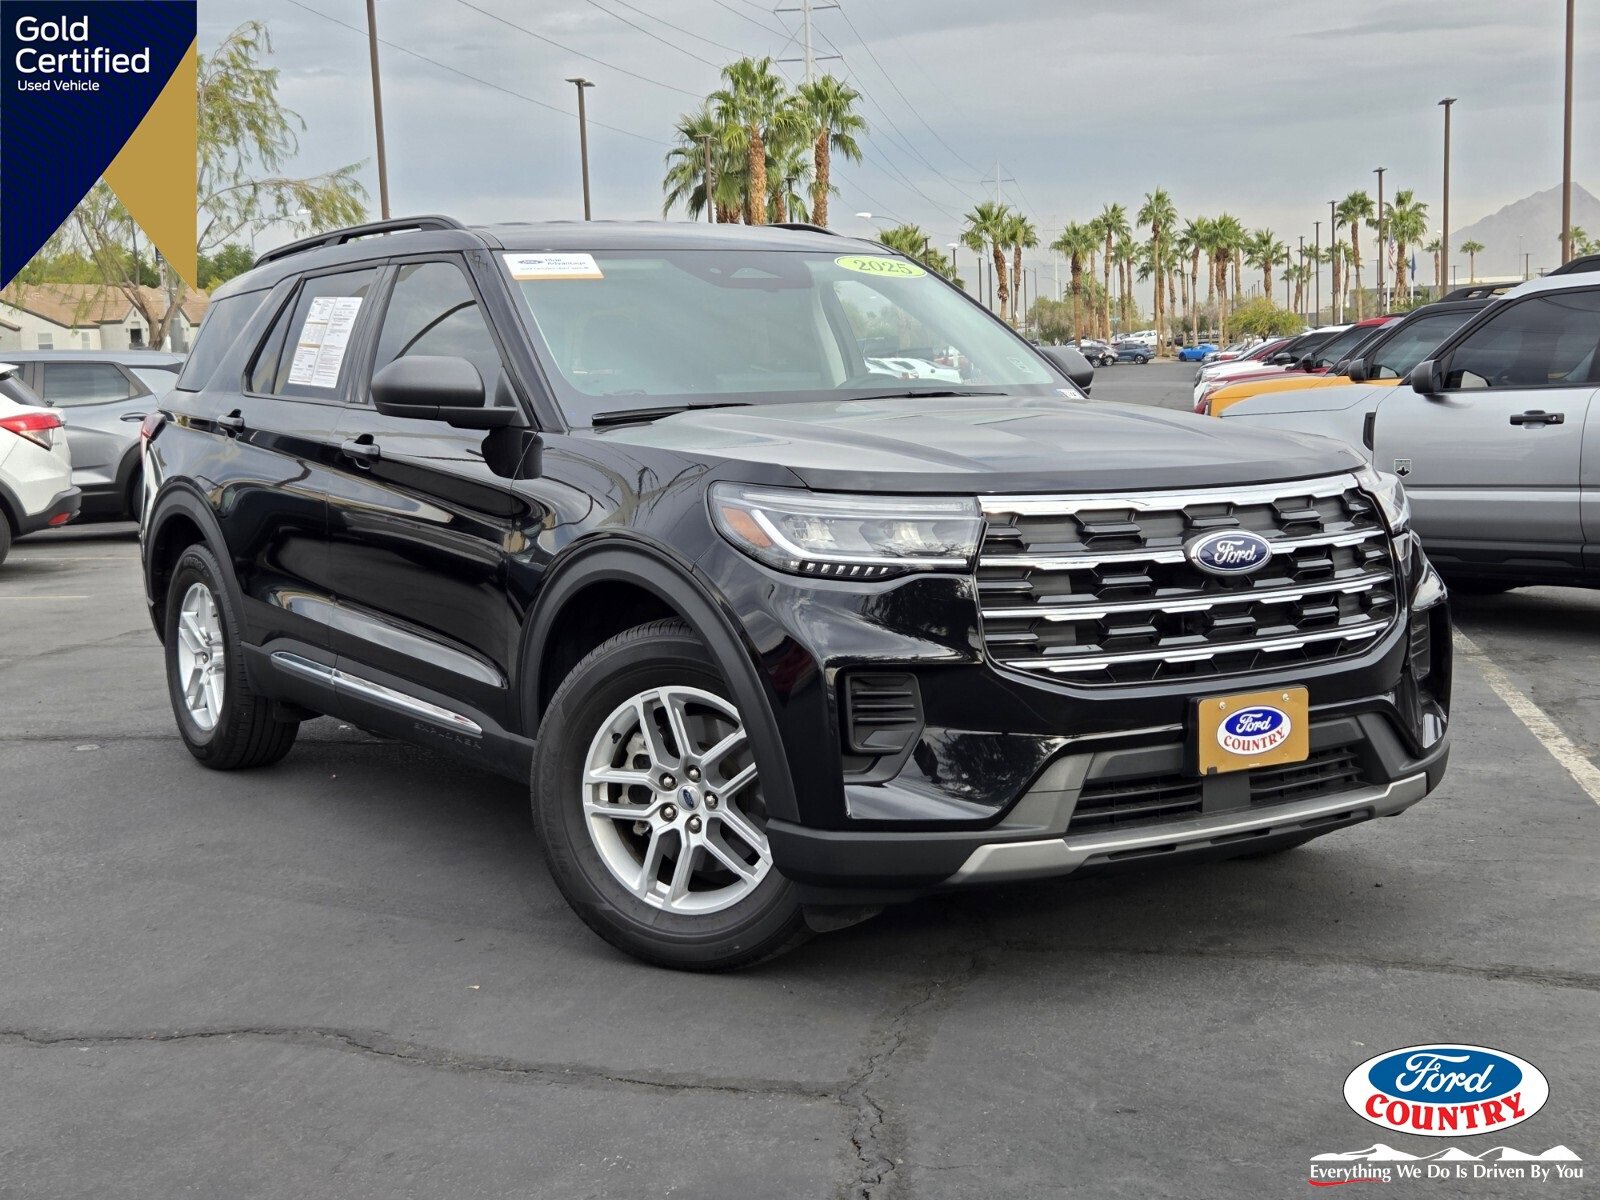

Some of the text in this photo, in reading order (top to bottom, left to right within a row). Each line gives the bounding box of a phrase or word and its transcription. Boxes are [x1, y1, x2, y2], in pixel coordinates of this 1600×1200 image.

[853, 259, 913, 275] 2025
[1213, 540, 1257, 565] Ford
[1235, 712, 1272, 734] Ford
[1223, 727, 1285, 752] COUNTRY
